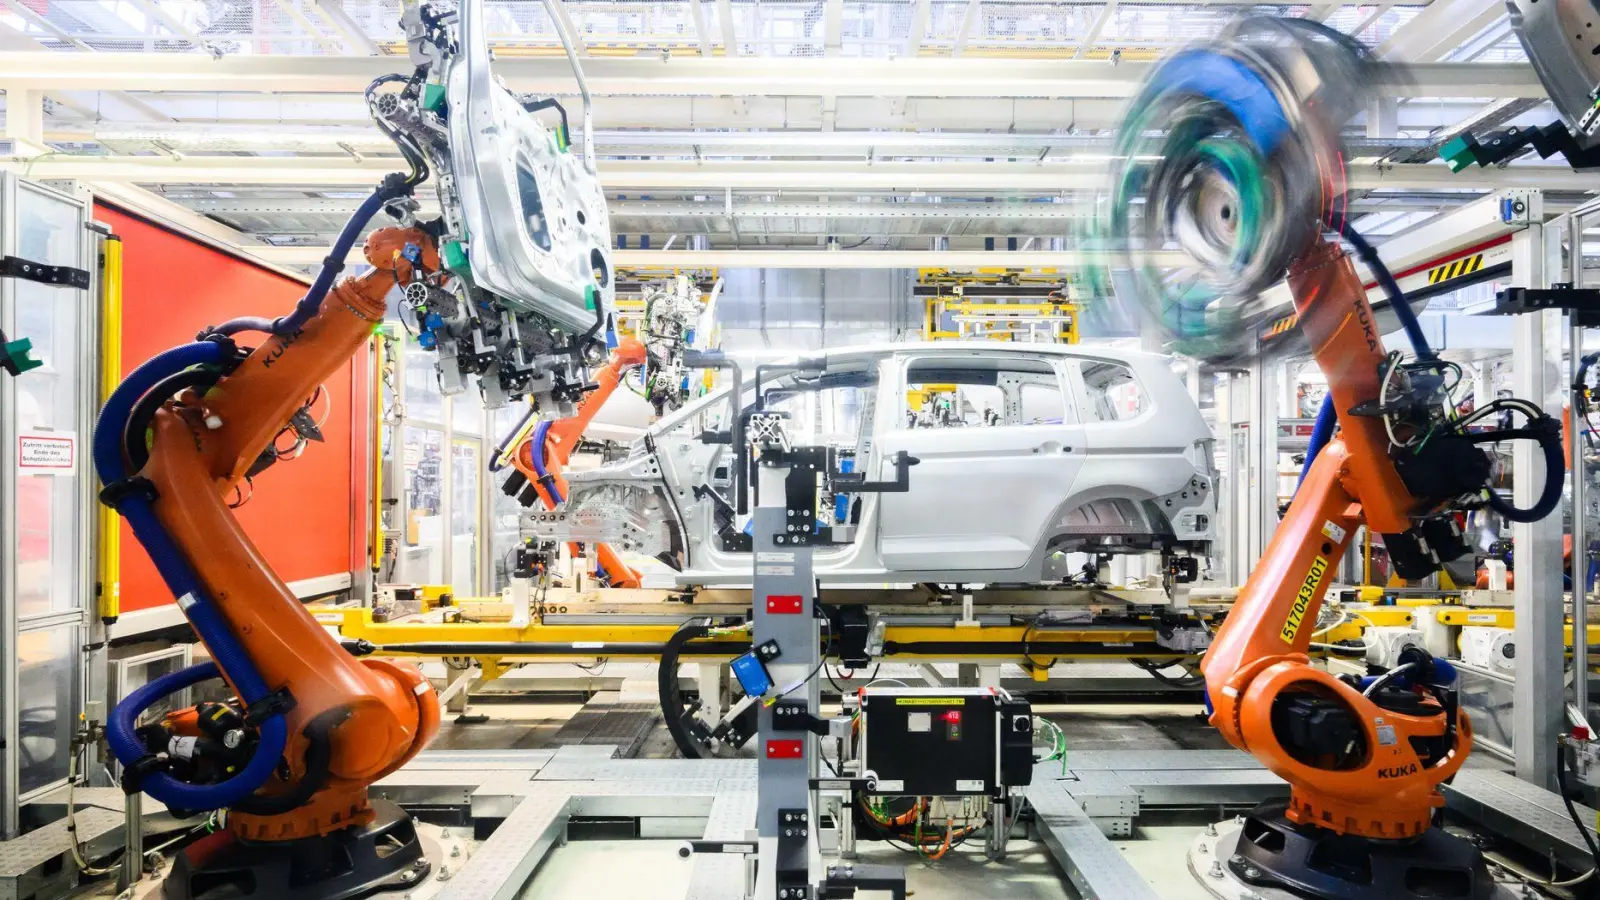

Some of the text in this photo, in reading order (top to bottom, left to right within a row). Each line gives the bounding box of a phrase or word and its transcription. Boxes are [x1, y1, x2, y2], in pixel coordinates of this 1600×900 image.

[262, 329, 305, 368] KUKA
[1353, 299, 1377, 352] KUKA
[1282, 558, 1327, 640] 517043R01
[1378, 763, 1418, 779] KUKA
